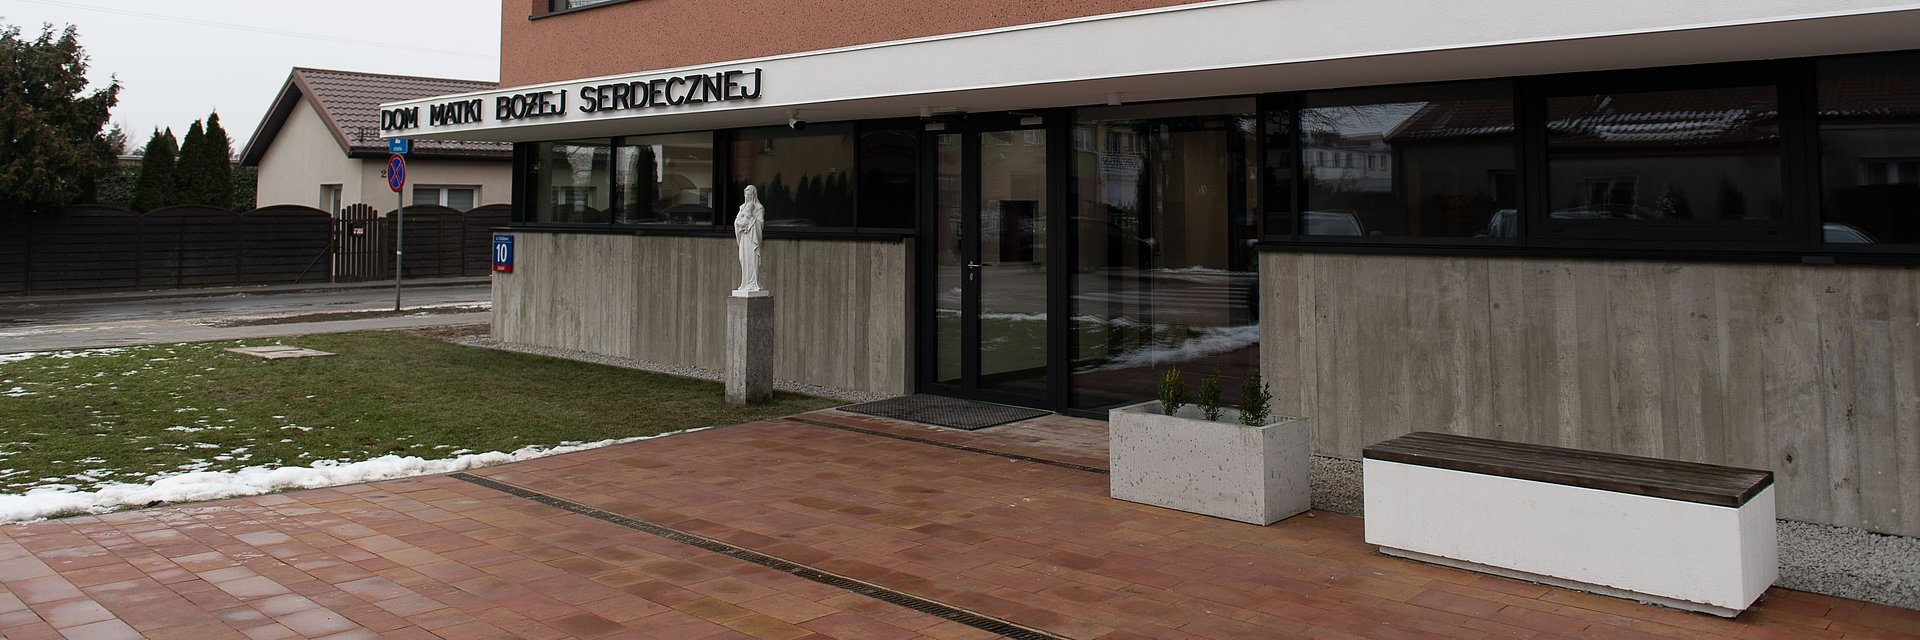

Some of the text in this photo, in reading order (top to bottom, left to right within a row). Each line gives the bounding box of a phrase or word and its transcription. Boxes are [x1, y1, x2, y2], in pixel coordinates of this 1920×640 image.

[381, 106, 419, 131] DOM
[429, 99, 483, 126] MATKI
[579, 68, 762, 113] SERDECZNEJ
[496, 243, 508, 263] 10
